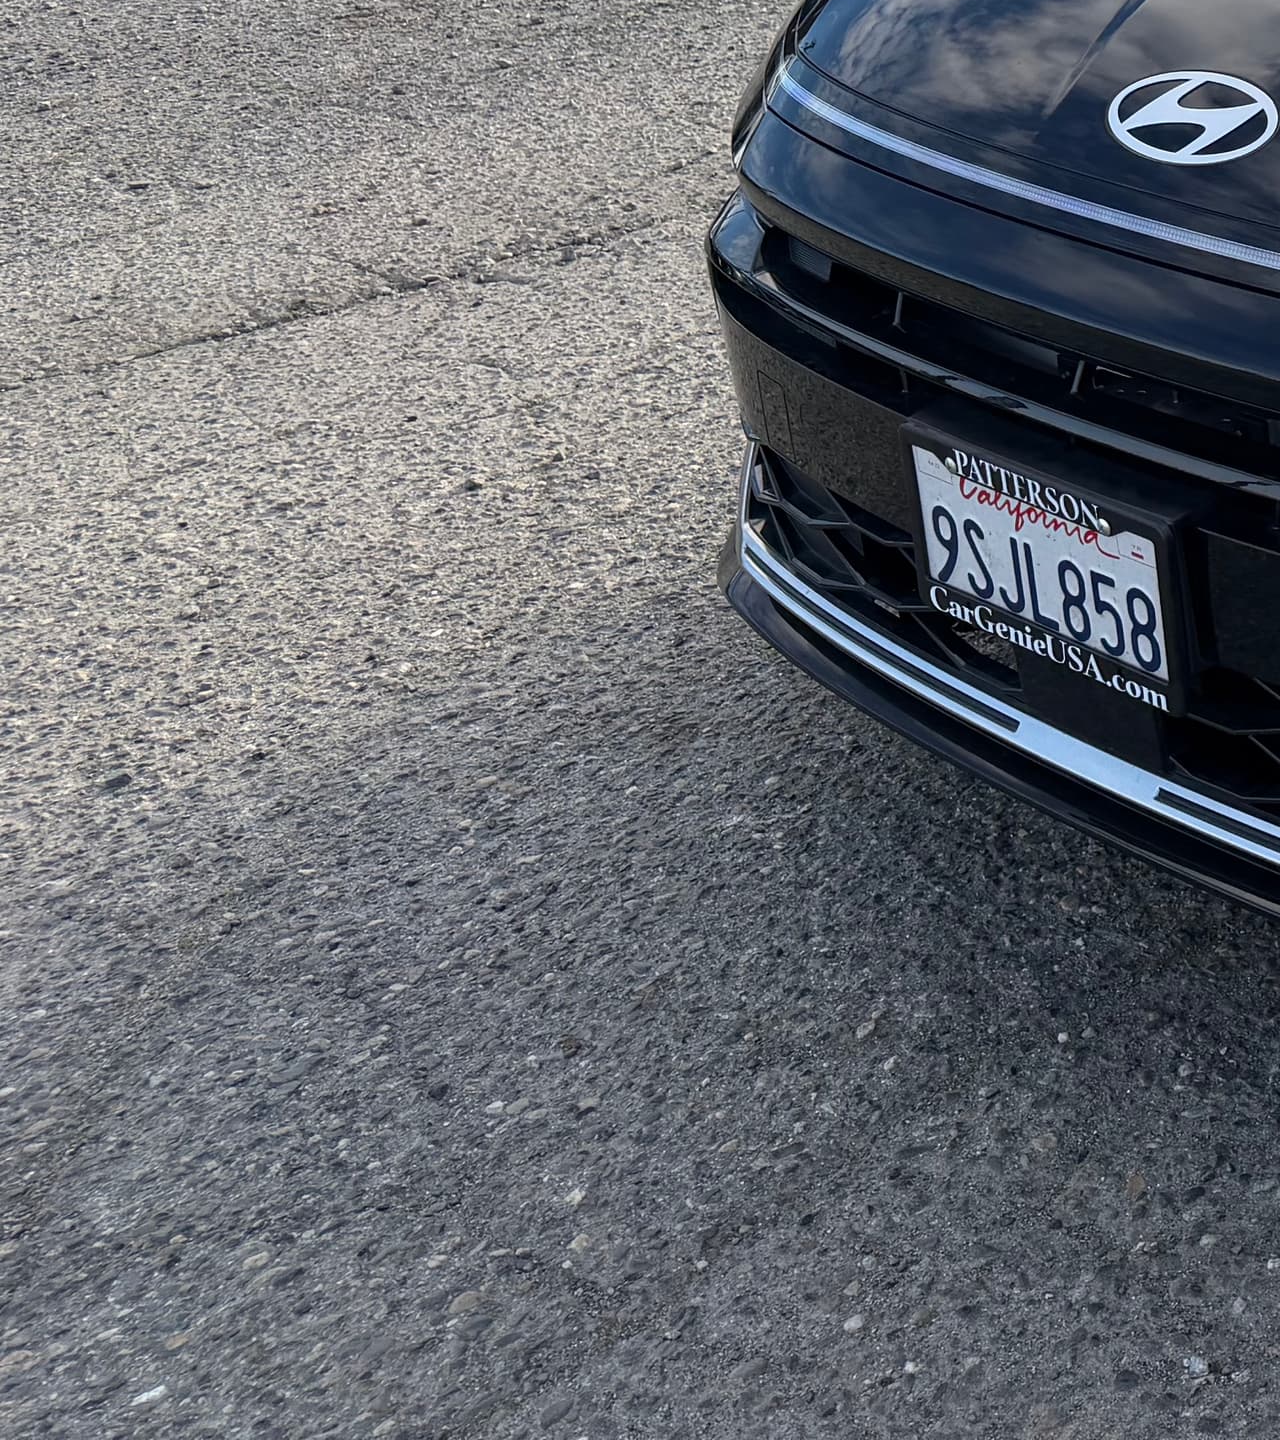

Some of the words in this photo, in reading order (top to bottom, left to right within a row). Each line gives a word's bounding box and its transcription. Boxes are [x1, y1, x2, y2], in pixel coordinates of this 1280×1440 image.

[951, 448, 1100, 532] PATTERSON
[959, 476, 1120, 560] California
[931, 504, 1162, 673] 9SJL858
[929, 585, 1170, 713] CarGenieUSA.com
